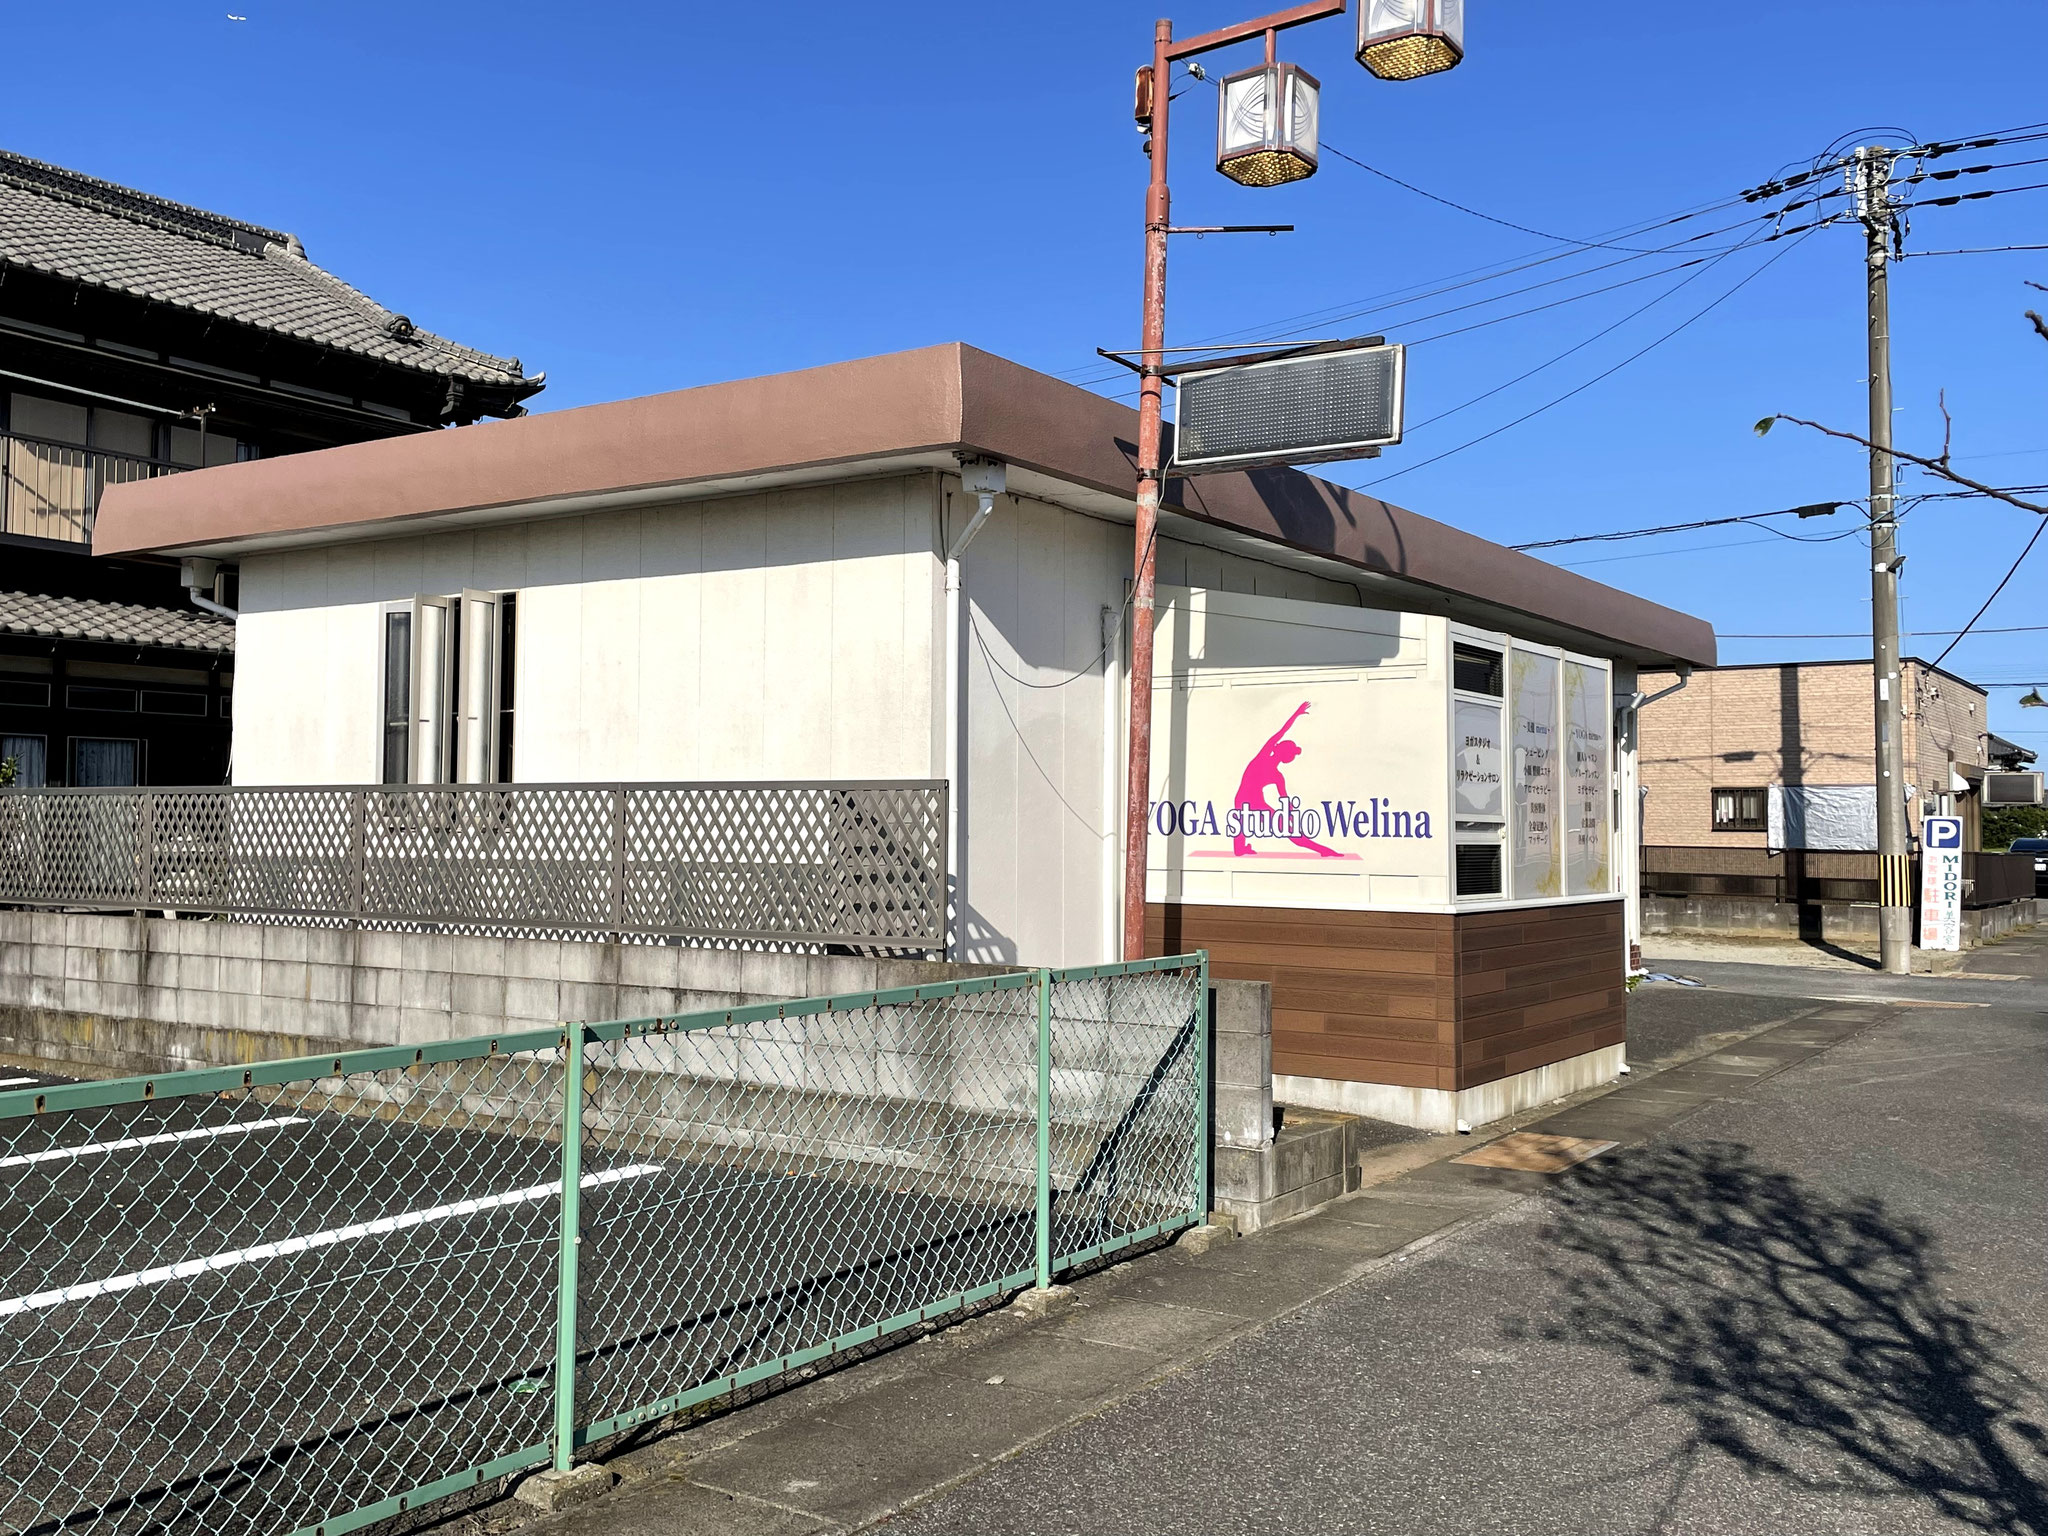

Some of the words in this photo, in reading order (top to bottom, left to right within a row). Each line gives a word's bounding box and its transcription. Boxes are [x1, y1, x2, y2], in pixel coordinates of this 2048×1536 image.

[1465, 735, 1491, 749] ヨガスタジオ
[1456, 769, 1500, 784] リラクゼーションサロン
[1524, 784, 1551, 795] アロマセラピー
[1225, 796, 1321, 839] studio
[1320, 797, 1433, 839] Welina
[1931, 820, 1958, 847] P
[1942, 854, 1960, 909] MIDORI
